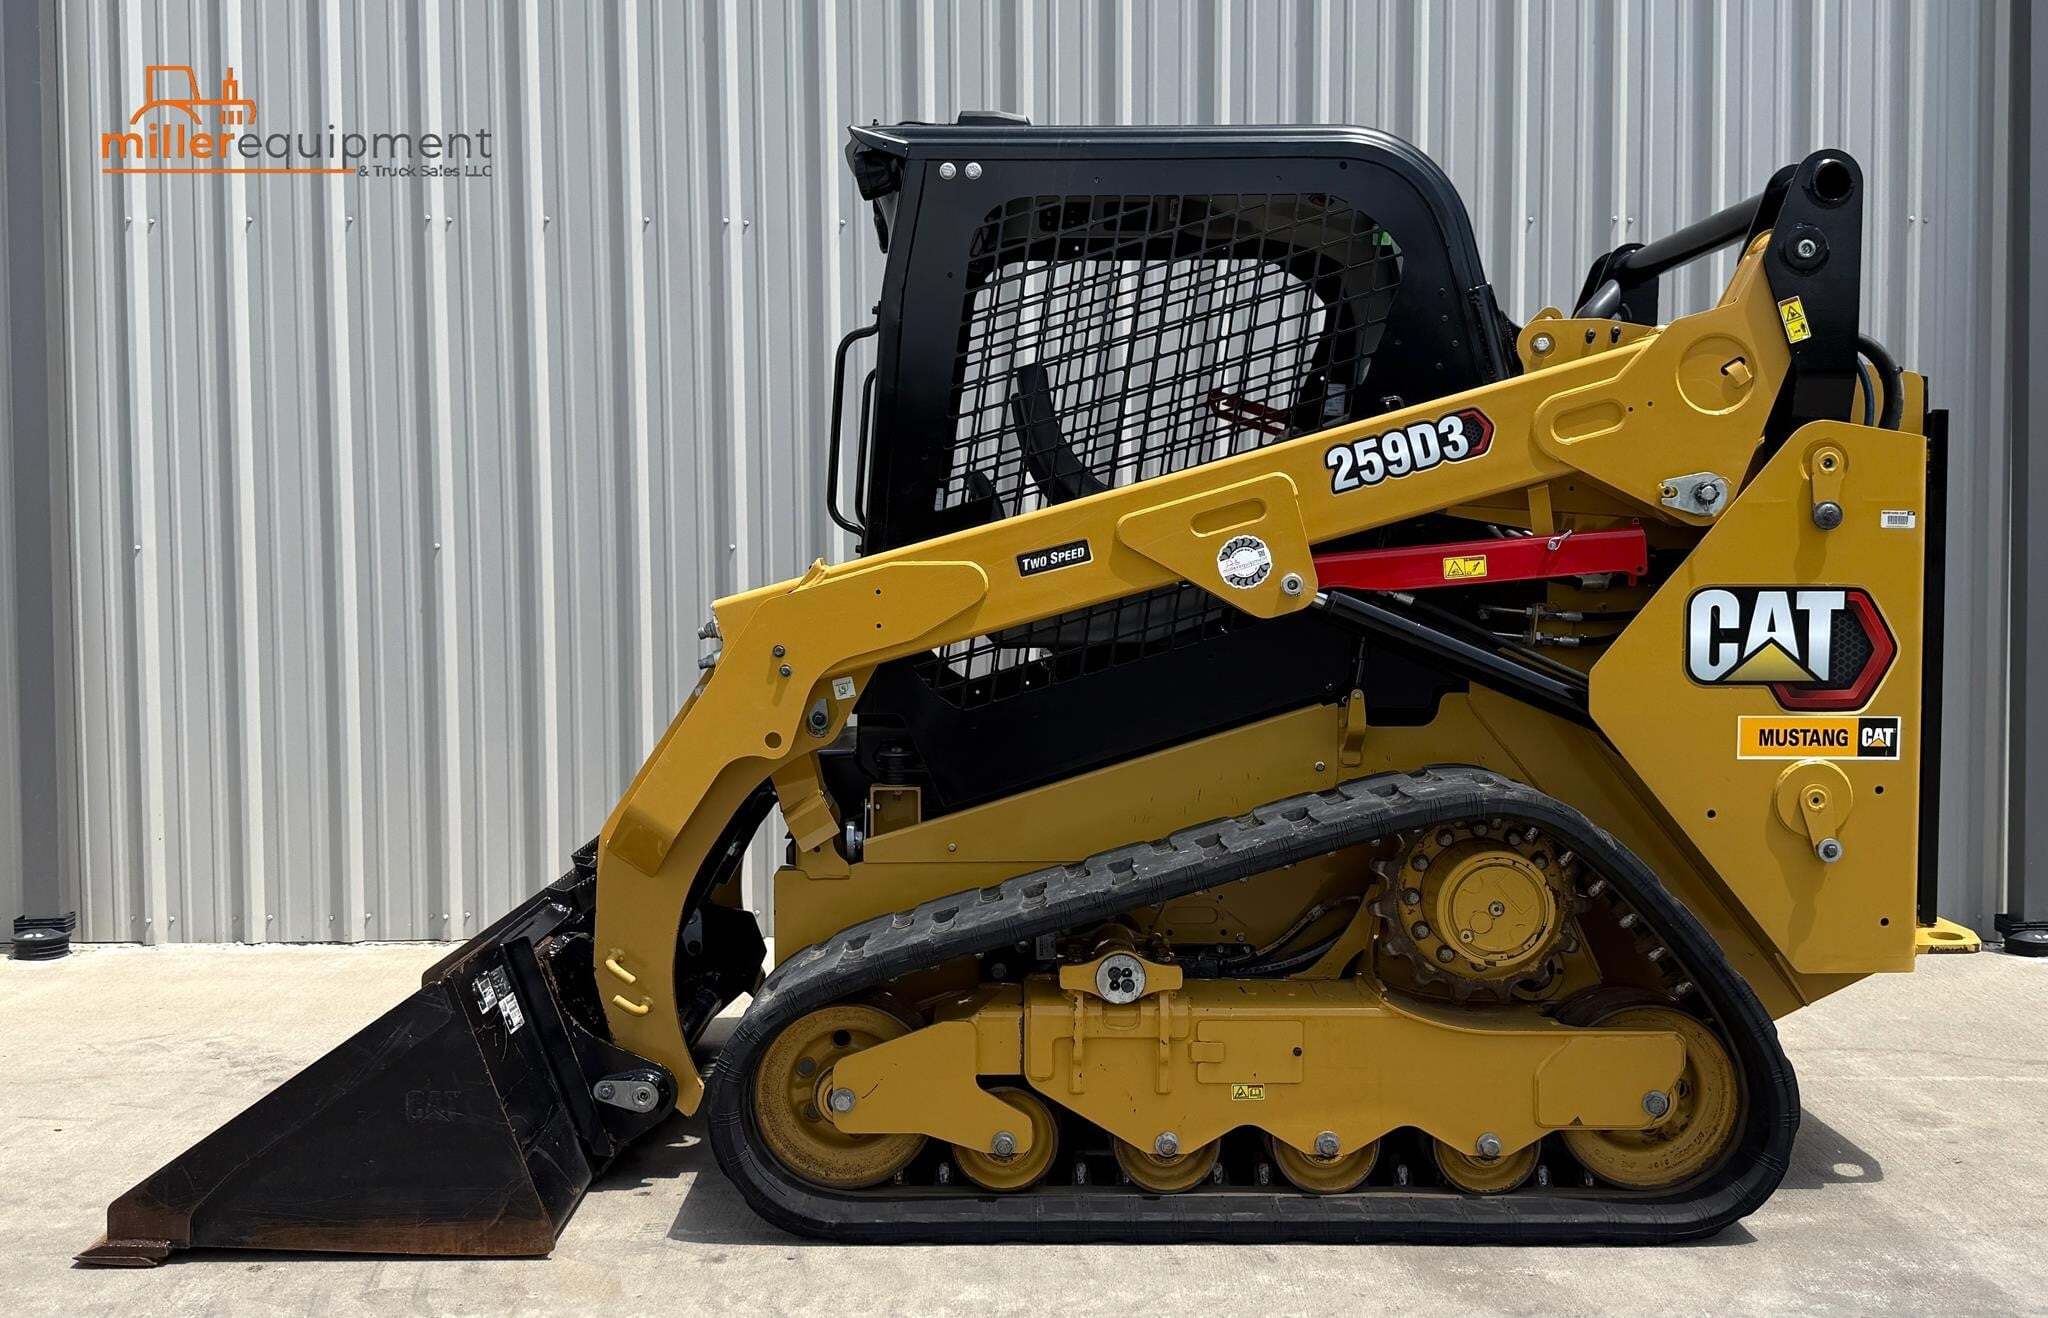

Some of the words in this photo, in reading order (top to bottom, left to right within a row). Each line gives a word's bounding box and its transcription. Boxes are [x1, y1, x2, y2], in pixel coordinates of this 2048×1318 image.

[1326, 414, 1470, 492] 259D3
[1689, 589, 1846, 682] CAT
[1758, 728, 1849, 747] MUSTANG
[1861, 727, 1894, 747] CAT
